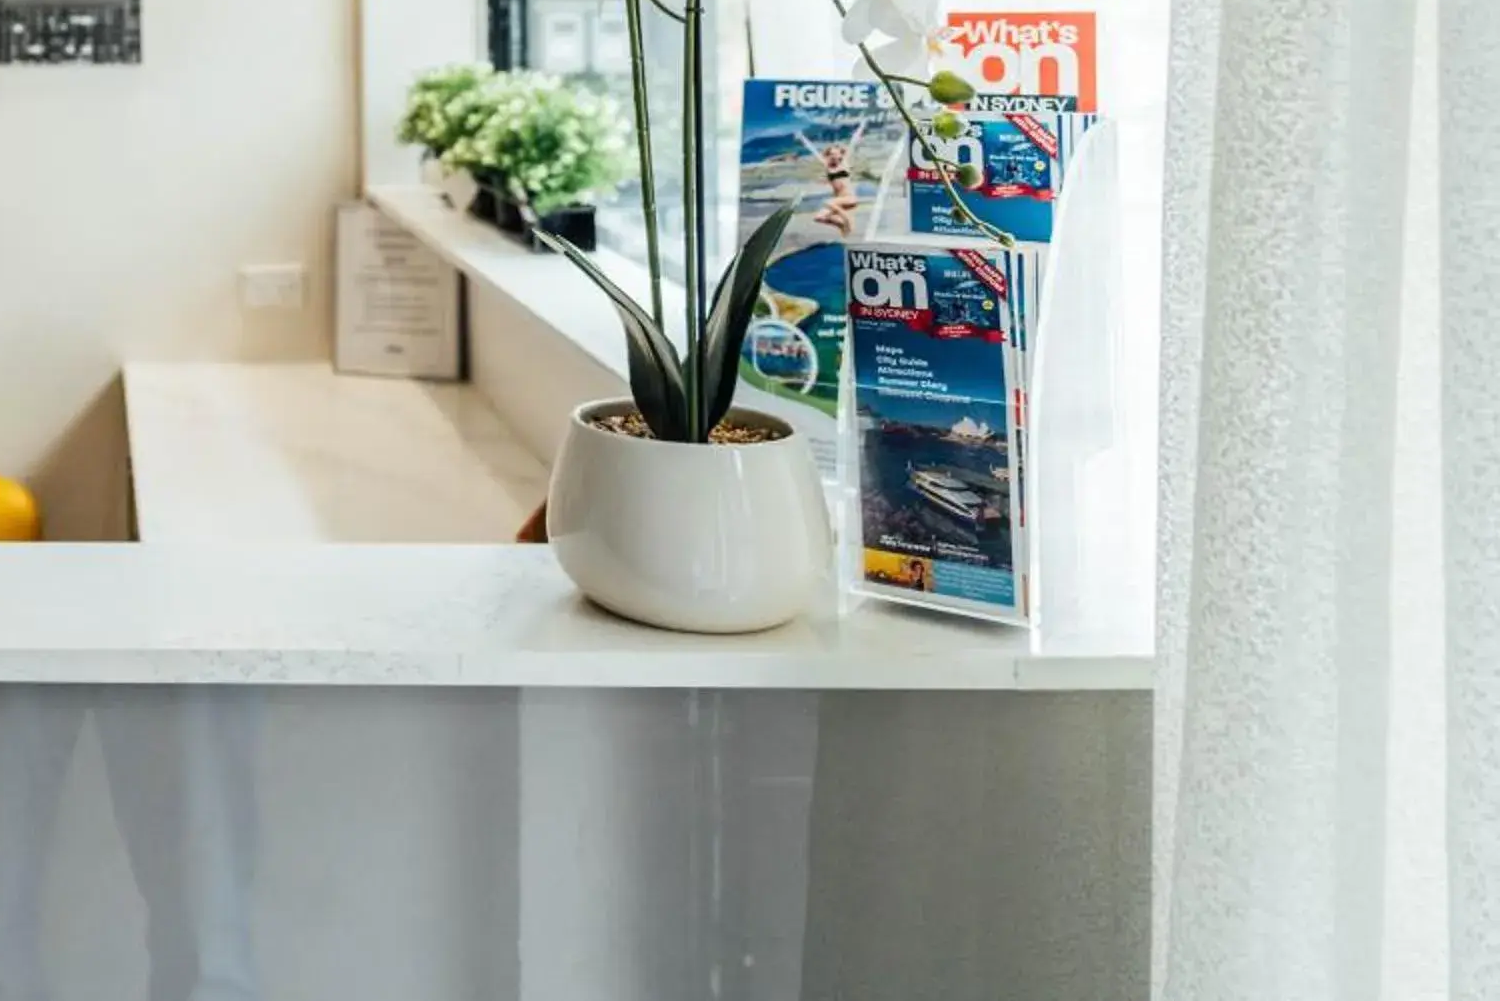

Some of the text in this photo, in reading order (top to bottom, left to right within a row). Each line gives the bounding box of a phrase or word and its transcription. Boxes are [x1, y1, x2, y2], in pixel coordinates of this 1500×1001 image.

[963, 19, 1079, 44] What's
[967, 43, 1079, 96] on
[774, 84, 869, 108] FIGURE
[970, 97, 1068, 111] IN SYDNEY
[851, 252, 927, 272] What's
[852, 267, 929, 309] on
[874, 308, 919, 320] SYDNEY
[875, 345, 904, 355] Maps
[876, 355, 898, 366] City
[878, 367, 934, 378] Attractions
